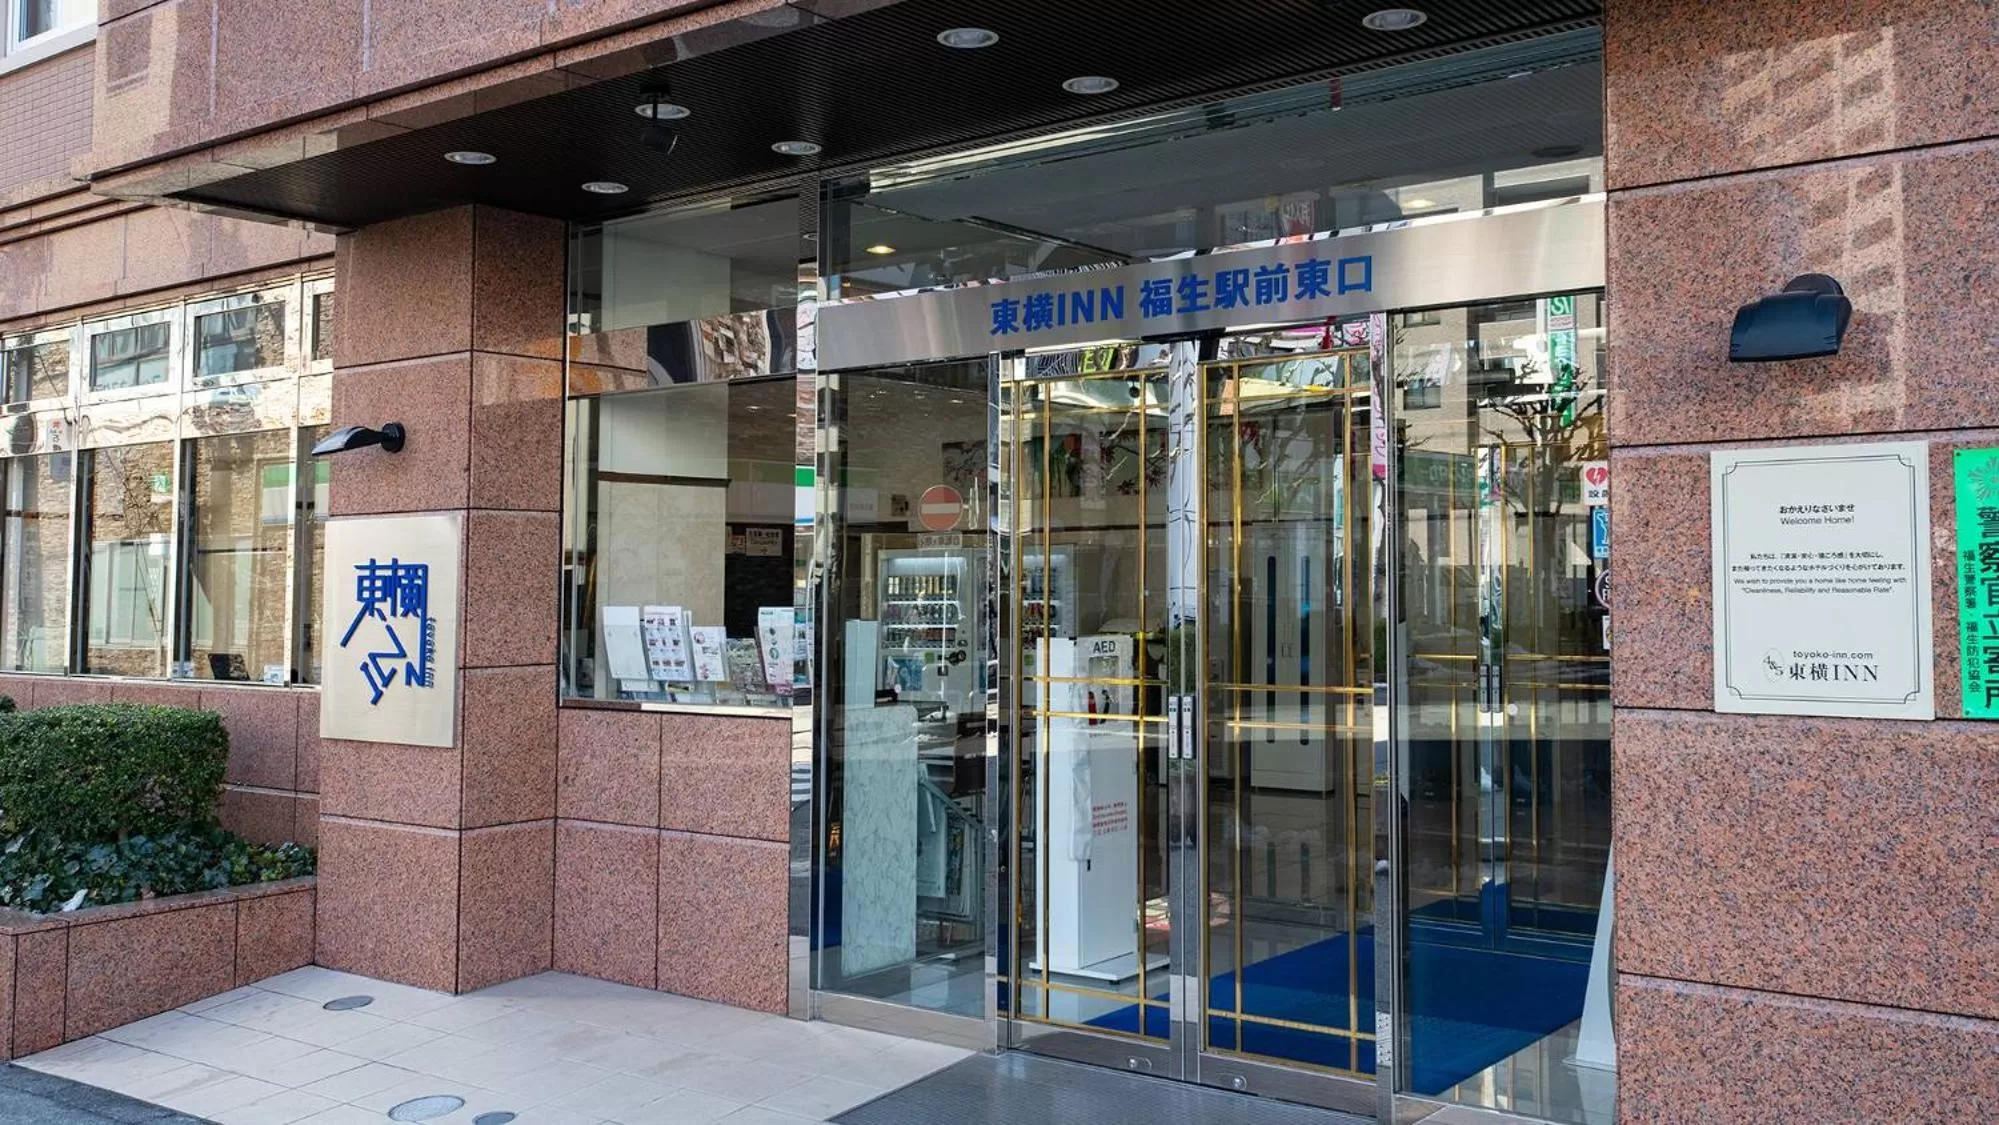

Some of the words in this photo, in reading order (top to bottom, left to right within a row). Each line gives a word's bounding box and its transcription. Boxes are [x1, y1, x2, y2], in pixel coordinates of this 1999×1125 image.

[989, 286, 1124, 336] 東横INN
[1139, 255, 1373, 319] 福生駅前東口
[1779, 503, 1855, 514] おかえりなさいませ
[1780, 516, 1822, 525] Welcome
[1824, 515, 1855, 525] Home!
[1092, 641, 1116, 654] AED
[1793, 650, 1873, 660] toyoko-inn.com
[1789, 662, 1879, 682] 東横INN
